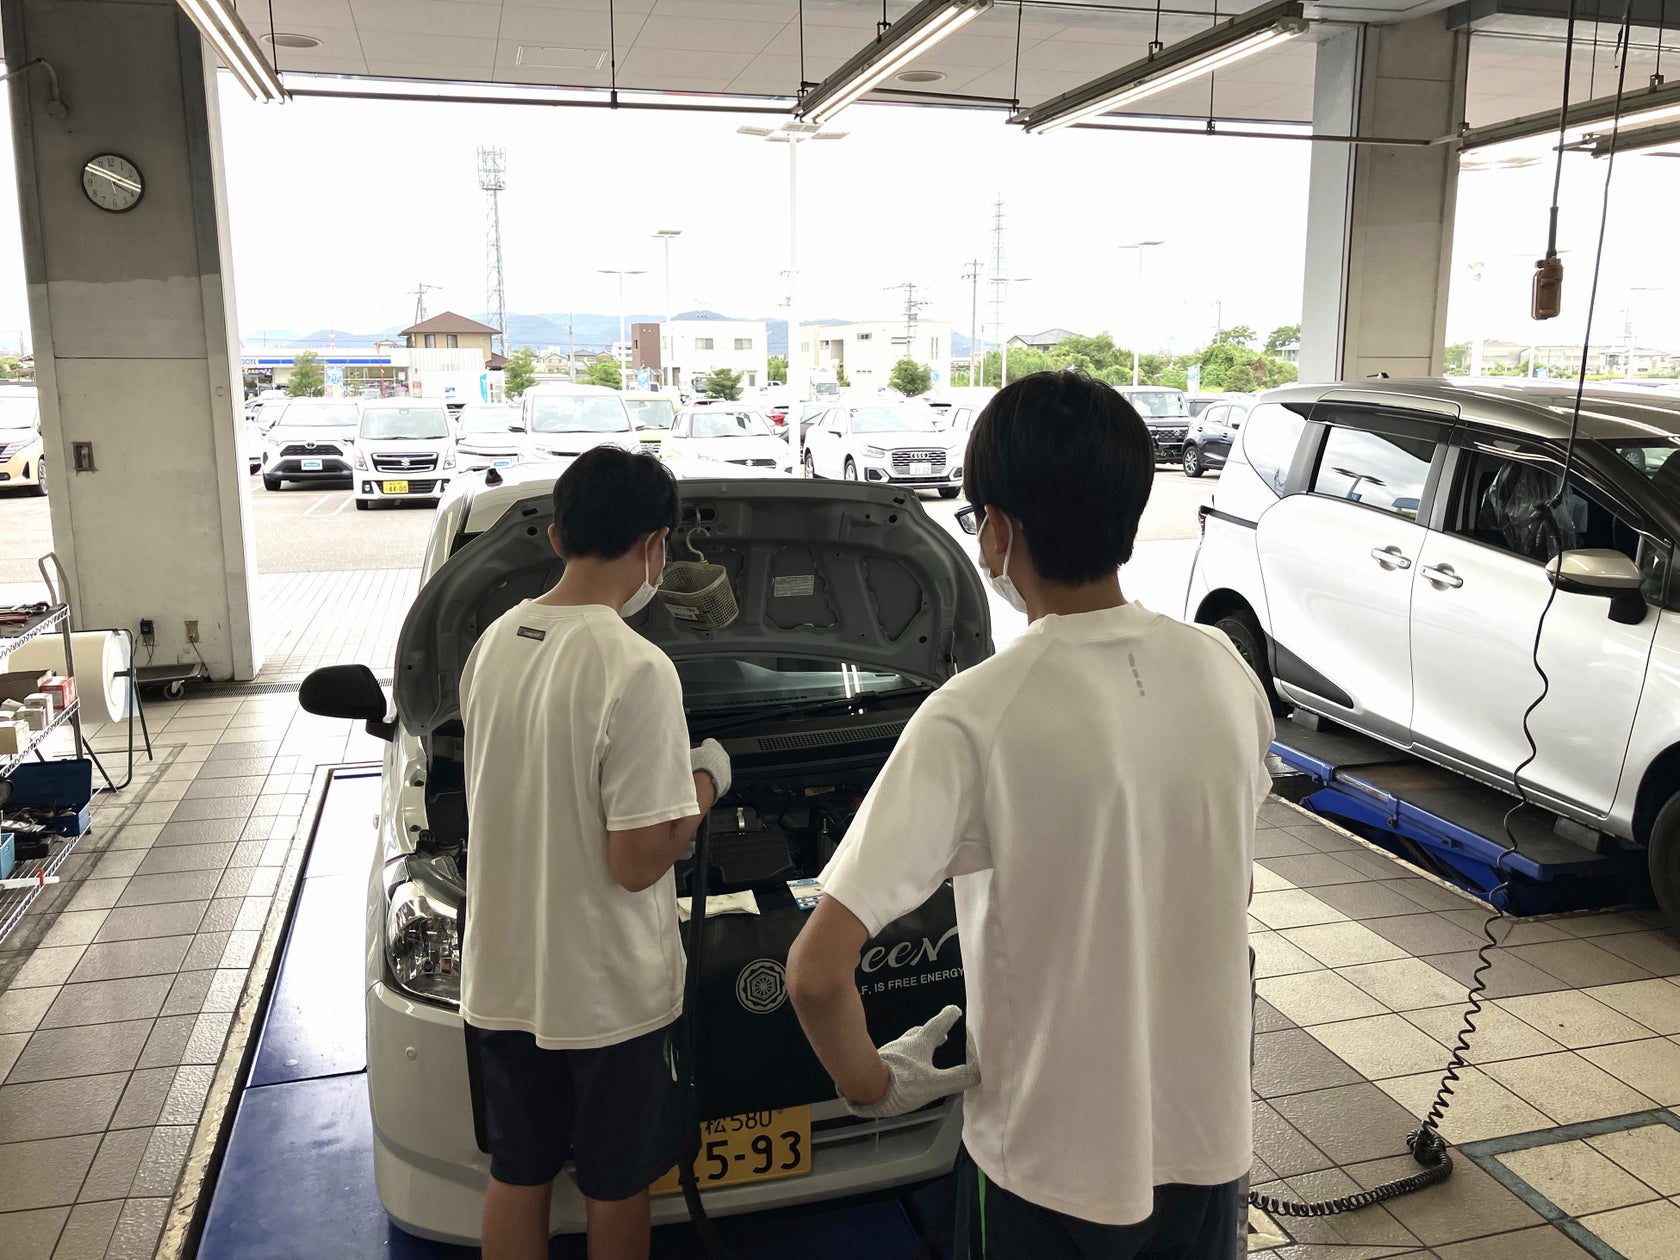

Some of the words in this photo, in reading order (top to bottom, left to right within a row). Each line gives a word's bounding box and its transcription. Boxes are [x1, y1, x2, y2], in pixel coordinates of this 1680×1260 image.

[861, 985, 872, 996] F,
[874, 982, 885, 993] IS
[888, 976, 918, 990] FREE
[920, 967, 964, 984] ENERGY
[680, 1130, 801, 1182] 5-93
